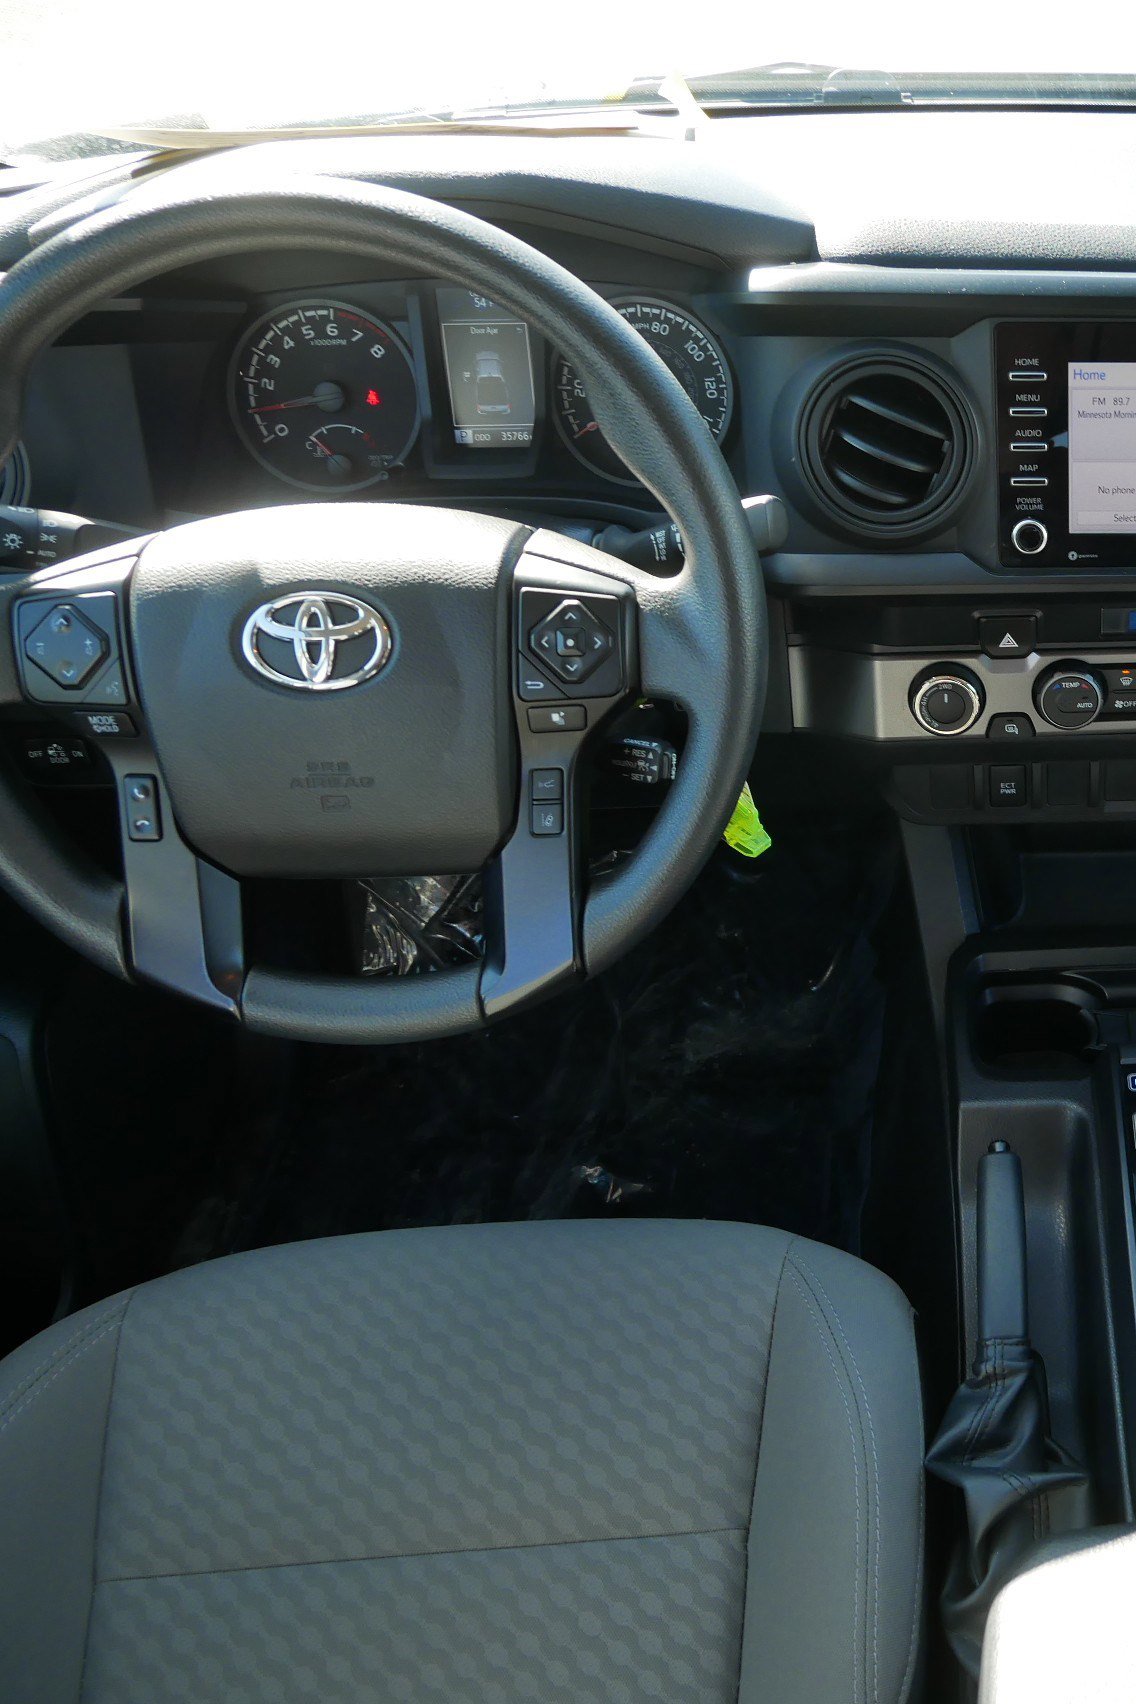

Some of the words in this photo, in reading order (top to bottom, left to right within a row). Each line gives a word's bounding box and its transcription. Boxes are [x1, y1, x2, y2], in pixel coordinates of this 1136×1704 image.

[302, 325, 315, 339] 5
[326, 324, 338, 336] 6
[651, 322, 670, 335] 80
[350, 329, 364, 341] 7
[283, 336, 295, 350] 4
[370, 344, 385, 358] 8
[684, 340, 705, 362] 100
[267, 354, 281, 368] 3
[1014, 358, 1040, 366] HOME
[1074, 369, 1106, 380] Home
[261, 378, 275, 390] 2
[704, 377, 718, 399] 120
[1015, 394, 1040, 402] MENU
[1092, 397, 1106, 405] FM
[1112, 397, 1130, 406] 89.7
[1077, 410, 1112, 418] Minnesota
[275, 424, 289, 437] 0
[1015, 429, 1042, 437] AUDIO
[502, 432, 529, 441] 35766
[1019, 464, 1039, 472] MAP
[1098, 486, 1110, 494] No
[1112, 486, 1136, 495] phone
[1113, 514, 1136, 522] Select
[88, 716, 118, 725] MODE
